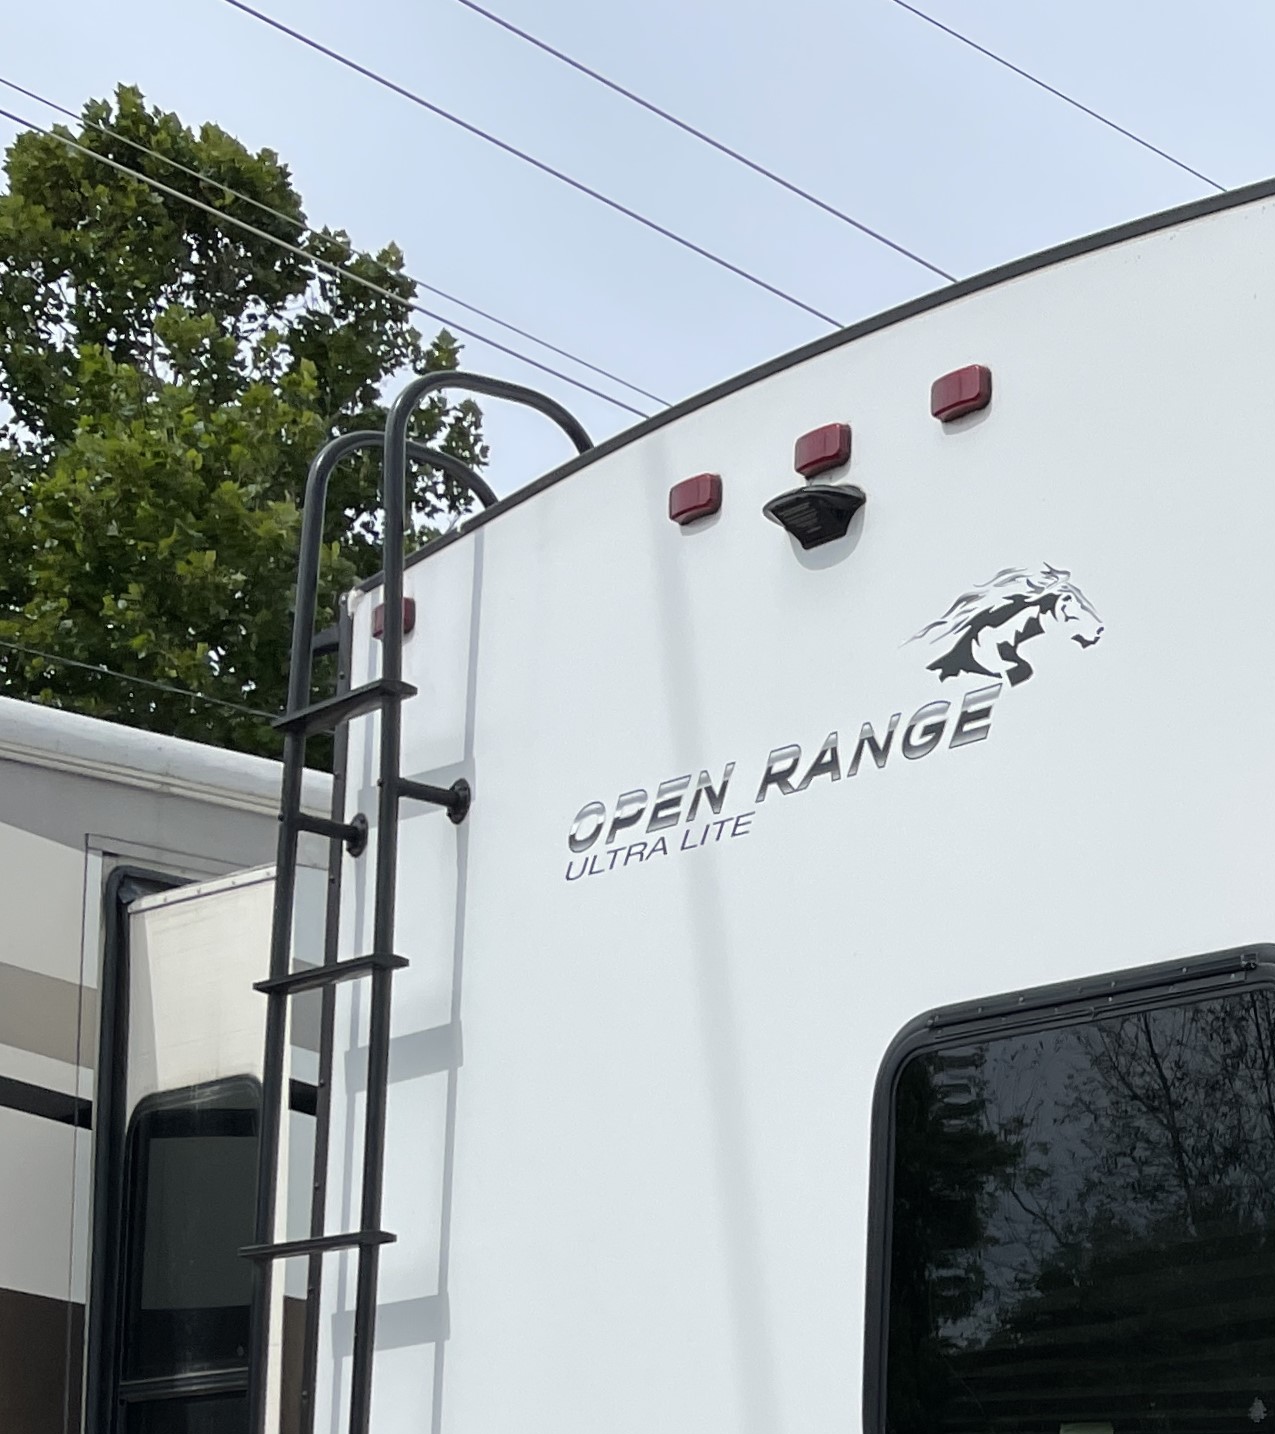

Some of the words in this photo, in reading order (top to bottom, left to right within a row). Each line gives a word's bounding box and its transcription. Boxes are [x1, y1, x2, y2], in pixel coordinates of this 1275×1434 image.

[567, 761, 735, 854] OPEN
[755, 682, 1002, 803] RANGE
[564, 837, 669, 881] ULTRA
[680, 812, 756, 851] LITE
